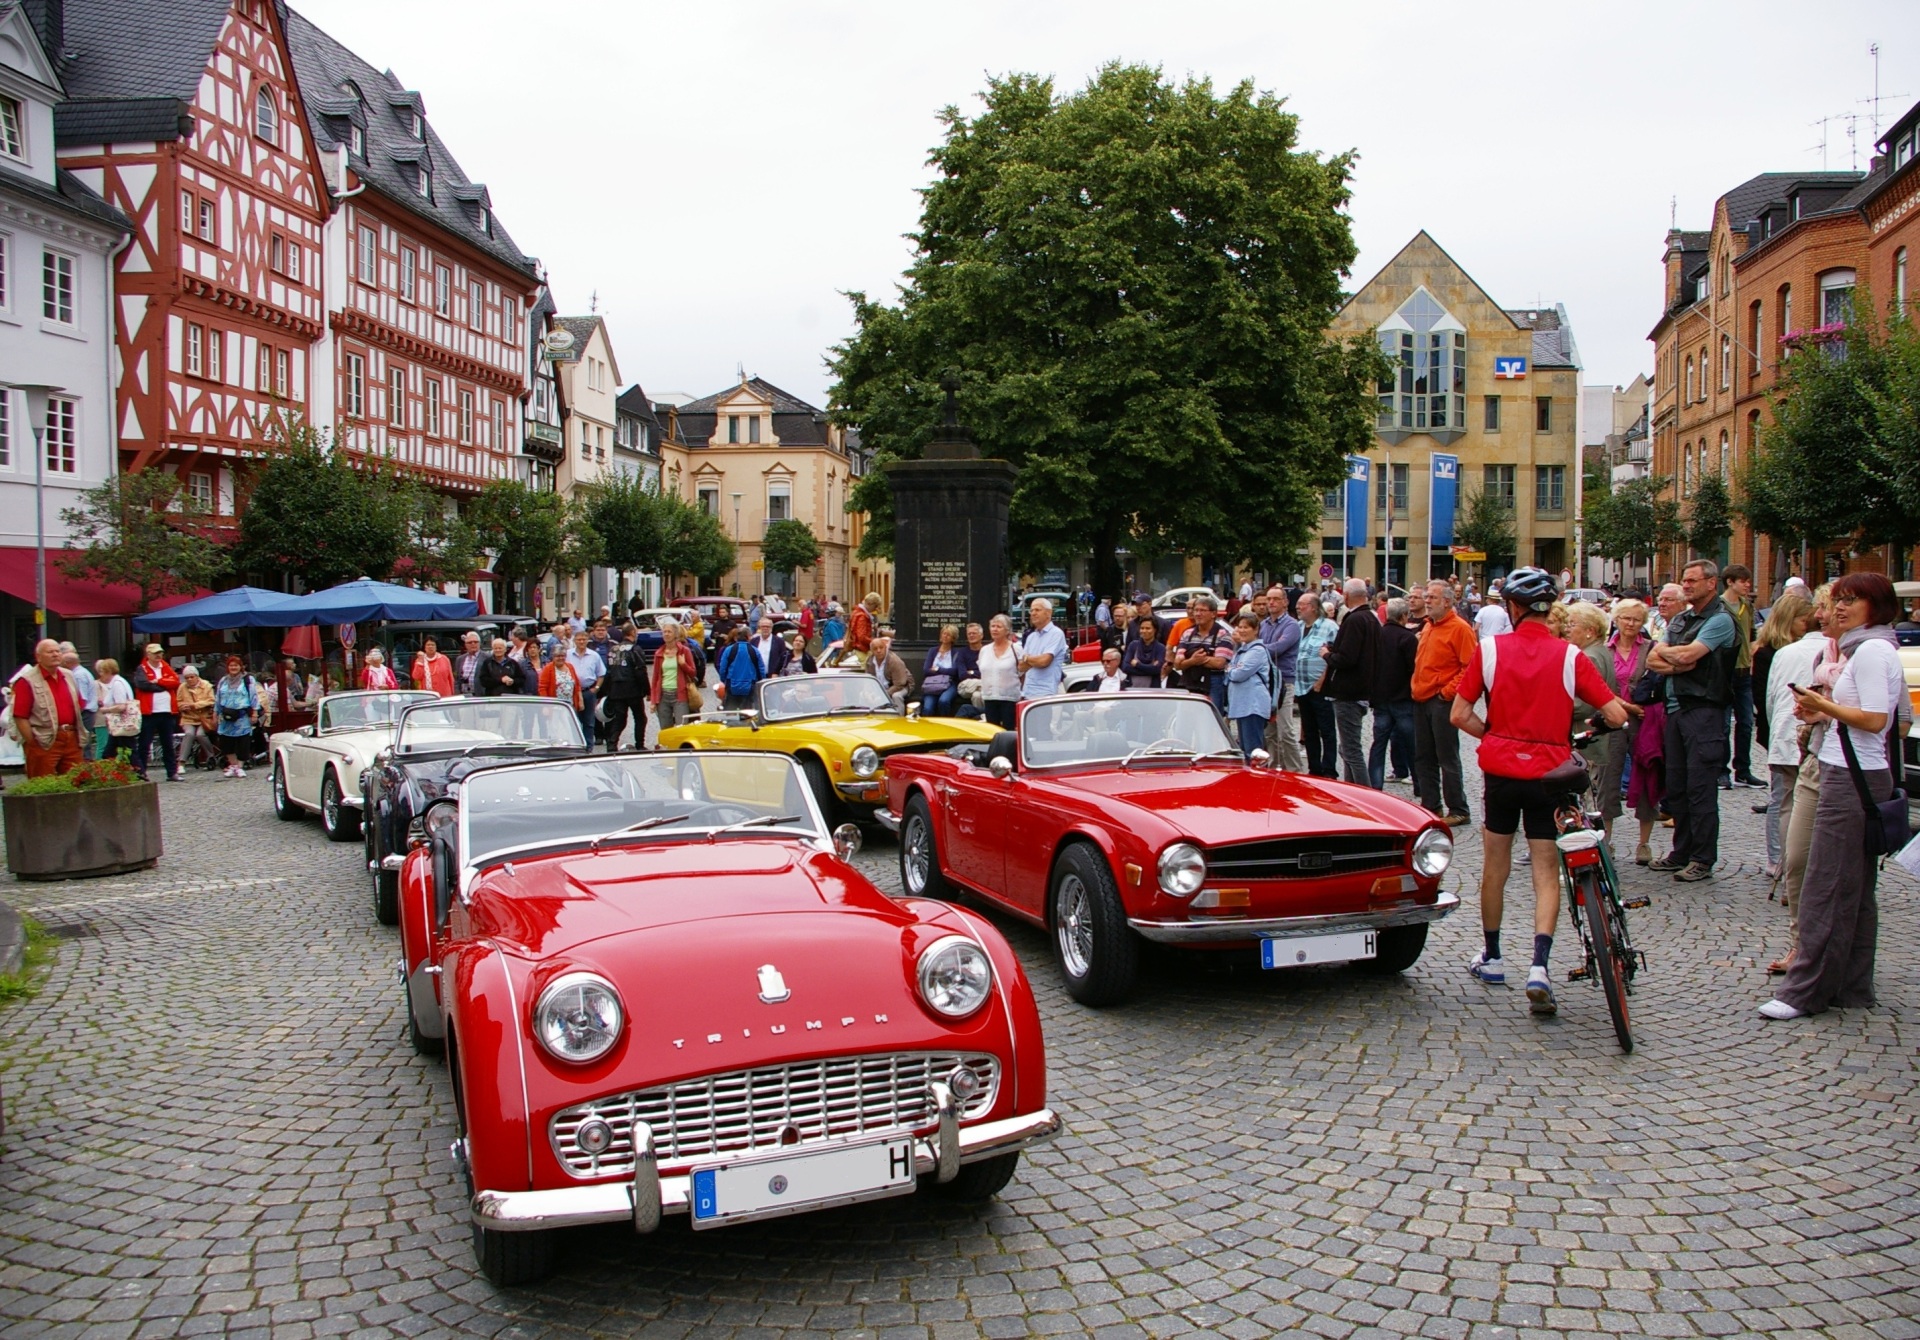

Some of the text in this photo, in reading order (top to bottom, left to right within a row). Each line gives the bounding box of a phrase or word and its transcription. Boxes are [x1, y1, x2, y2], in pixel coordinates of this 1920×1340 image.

[1365, 934, 1375, 954] H
[672, 1014, 888, 1049] TRIUMPH
[890, 1144, 909, 1179] H
[702, 1198, 711, 1209] D
